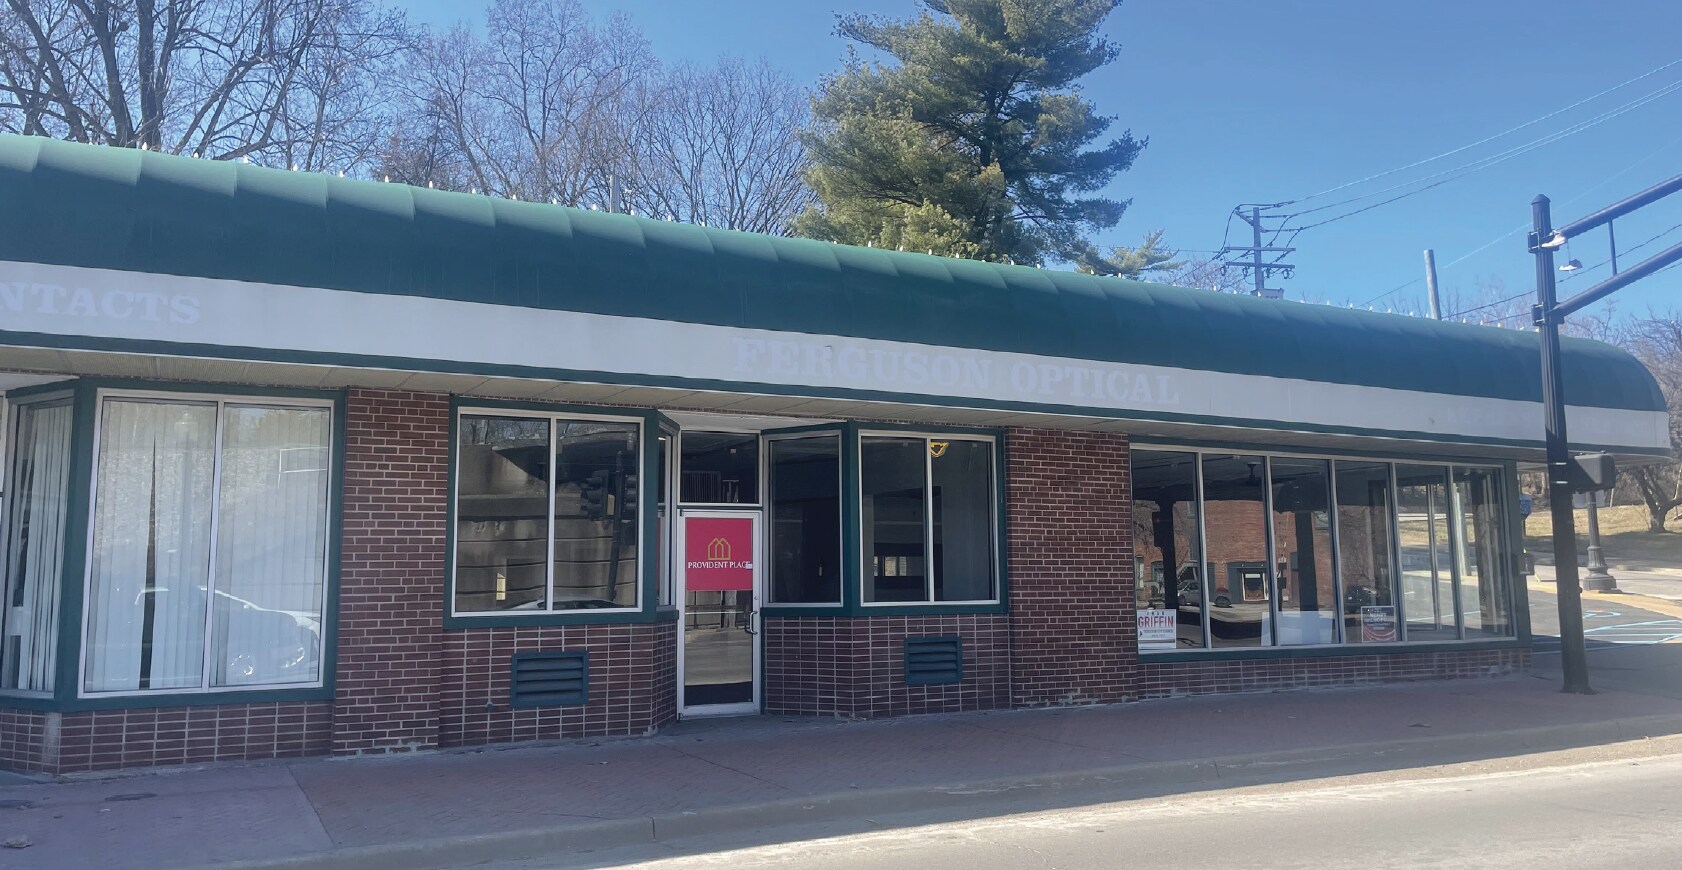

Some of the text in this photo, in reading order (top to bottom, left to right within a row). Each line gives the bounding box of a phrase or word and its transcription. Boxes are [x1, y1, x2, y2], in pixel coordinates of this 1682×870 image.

[731, 337, 1181, 406] FERGUSON OPTICAL
[687, 561, 728, 569] PROVIDENT
[1138, 616, 1174, 628] GRIFFIN
